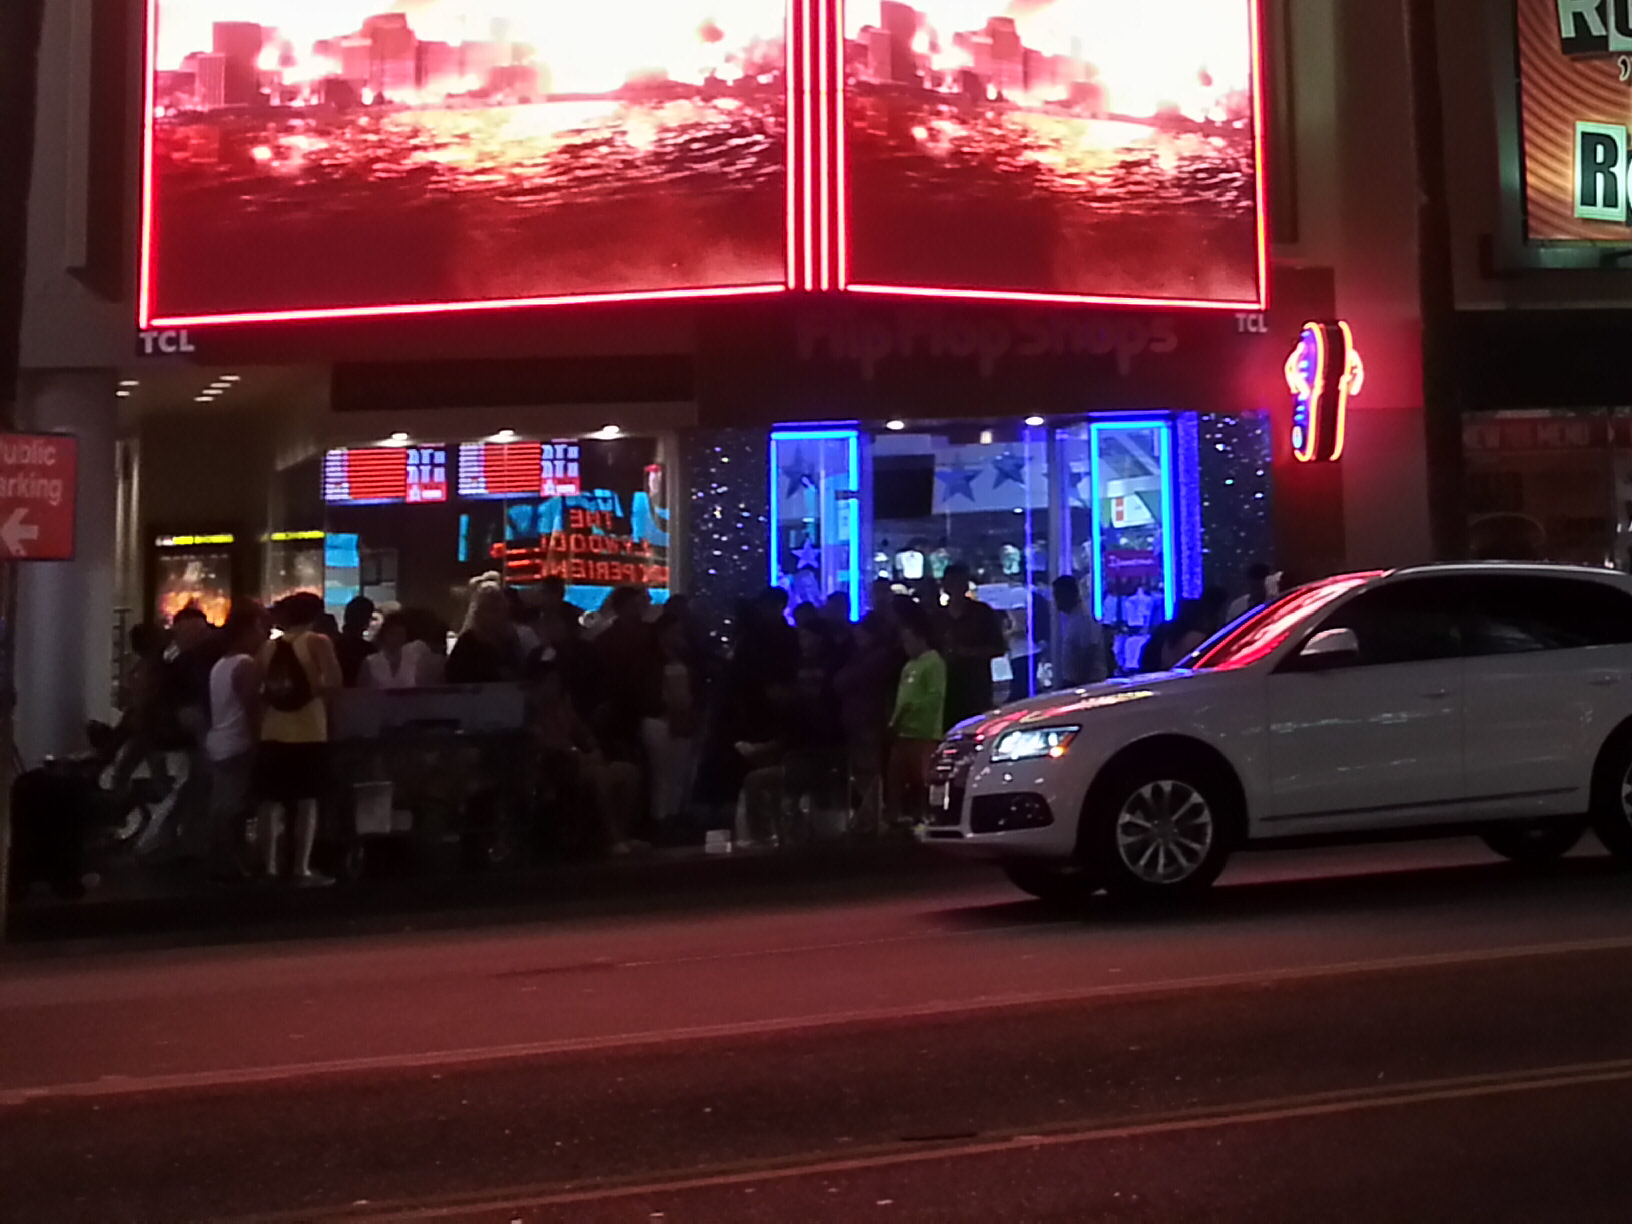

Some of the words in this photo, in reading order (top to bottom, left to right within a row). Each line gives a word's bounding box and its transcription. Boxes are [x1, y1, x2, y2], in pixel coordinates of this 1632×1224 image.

[1234, 312, 1268, 333] TCL
[139, 329, 195, 354] TCL
[0, 439, 57, 467] ublic
